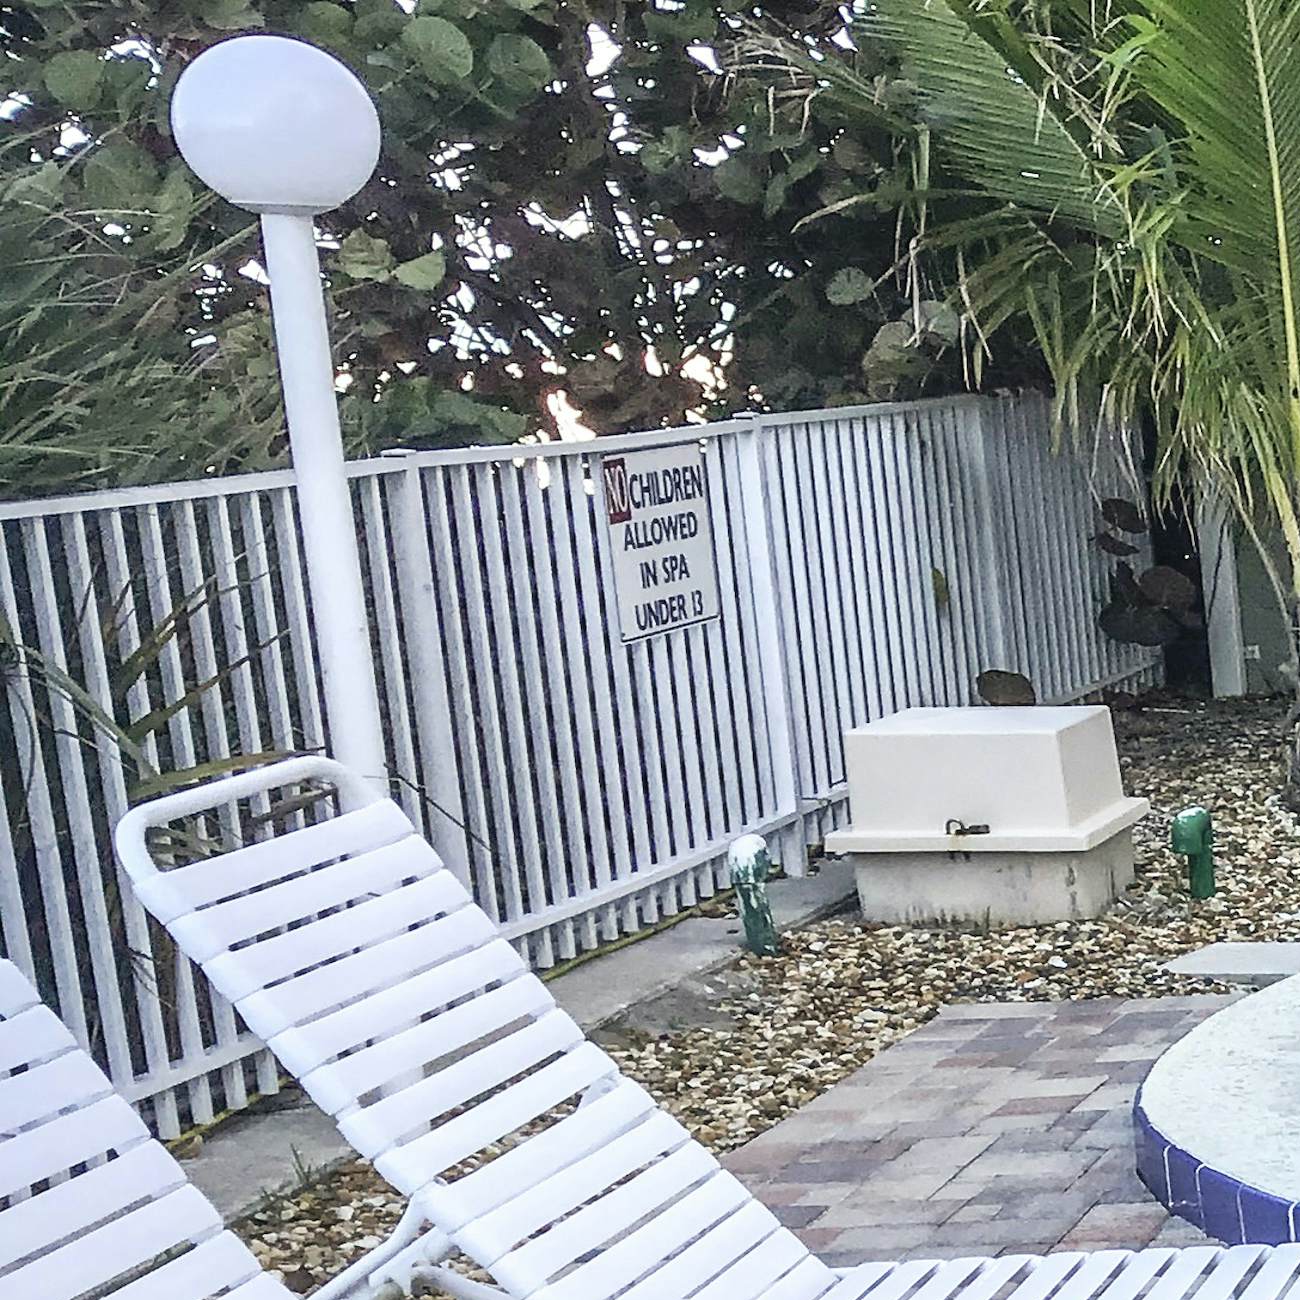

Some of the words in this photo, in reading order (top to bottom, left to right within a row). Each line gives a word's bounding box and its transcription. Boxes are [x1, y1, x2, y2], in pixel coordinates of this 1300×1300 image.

[604, 466, 629, 514] NO
[629, 464, 704, 509] CHILDREN
[624, 511, 698, 551] ALLOWED
[639, 559, 658, 589] IN
[662, 553, 690, 584] SPA
[634, 594, 688, 630] UNDER
[691, 589, 704, 616] 13
